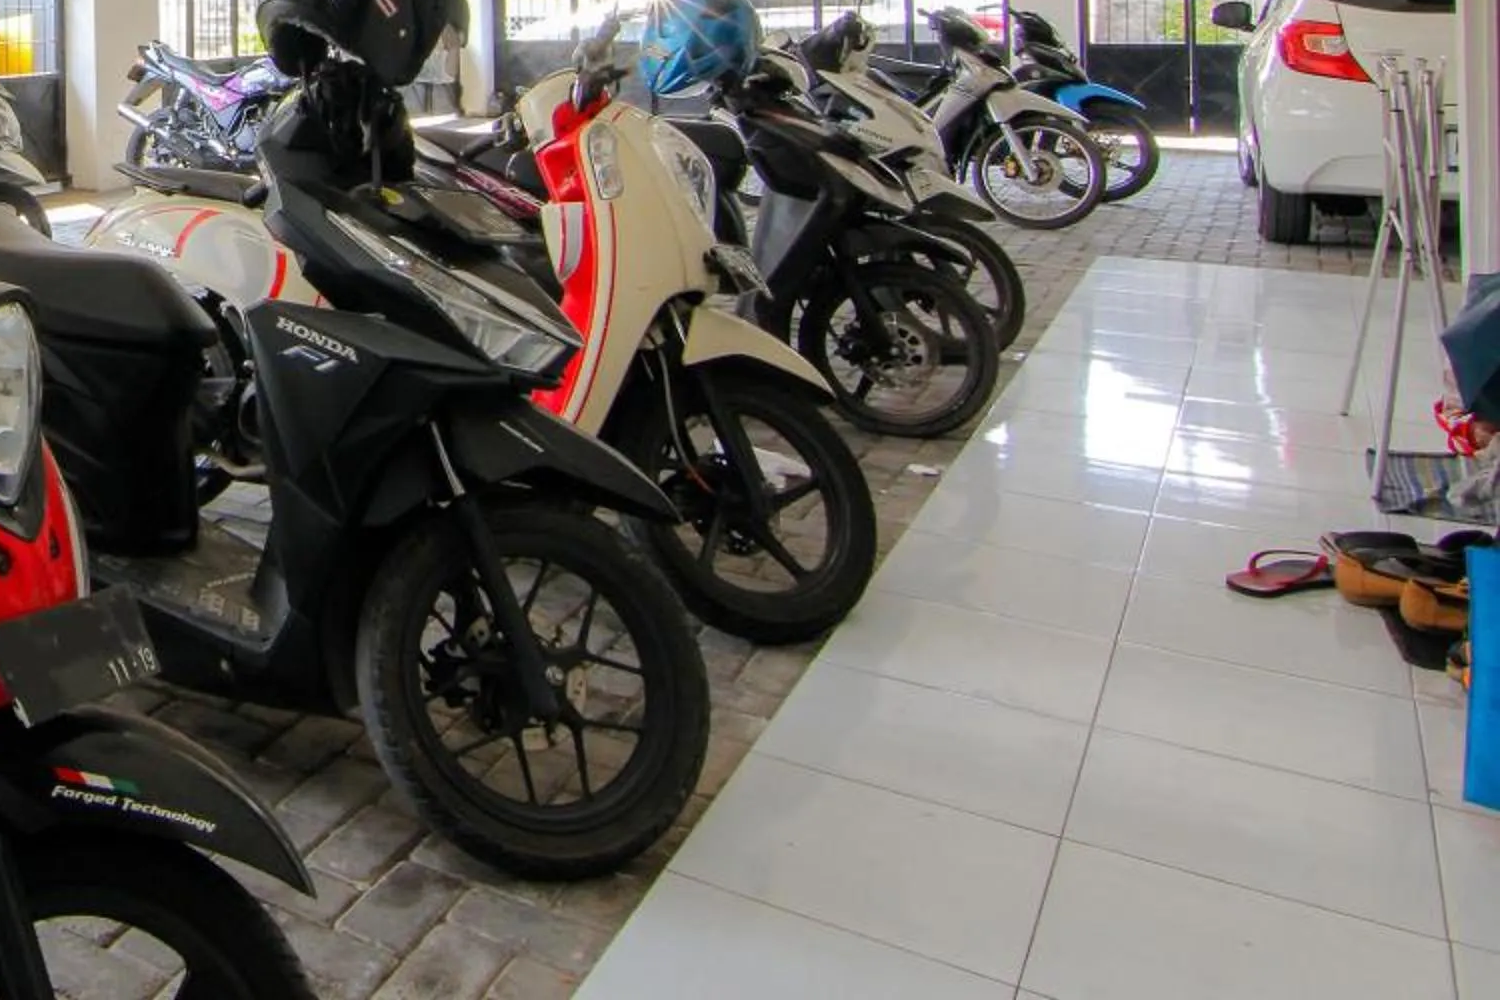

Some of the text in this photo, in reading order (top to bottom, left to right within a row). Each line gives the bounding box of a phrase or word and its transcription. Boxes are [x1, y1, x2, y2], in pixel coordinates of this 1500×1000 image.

[276, 316, 358, 363] HONDA
[51, 784, 217, 833] Forged Technology
